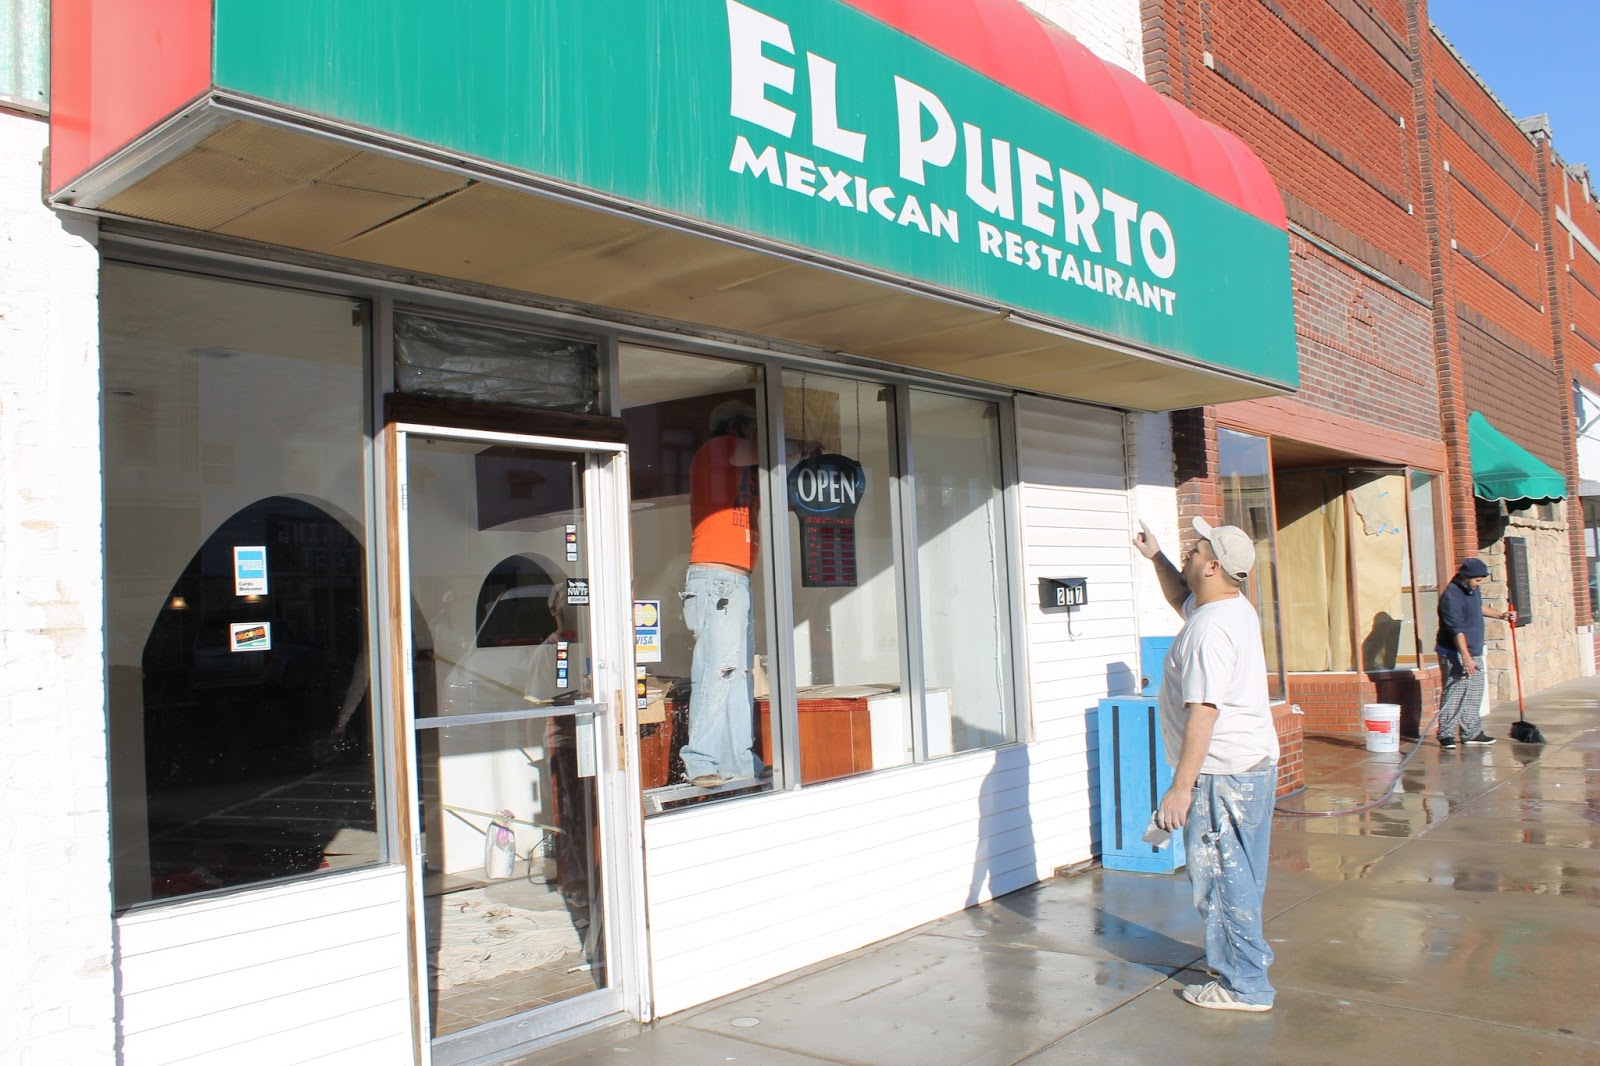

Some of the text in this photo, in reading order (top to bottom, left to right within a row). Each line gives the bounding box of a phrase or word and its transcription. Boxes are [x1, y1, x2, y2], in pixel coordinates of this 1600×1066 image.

[726, 0, 1176, 280] EL PUERTO
[729, 135, 1176, 316] MEXICAN RESTAURANT
[798, 468, 856, 504] OPEN
[567, 587, 589, 596] NWTF
[1058, 587, 1082, 604] 217
[635, 635, 653, 645] VISA
